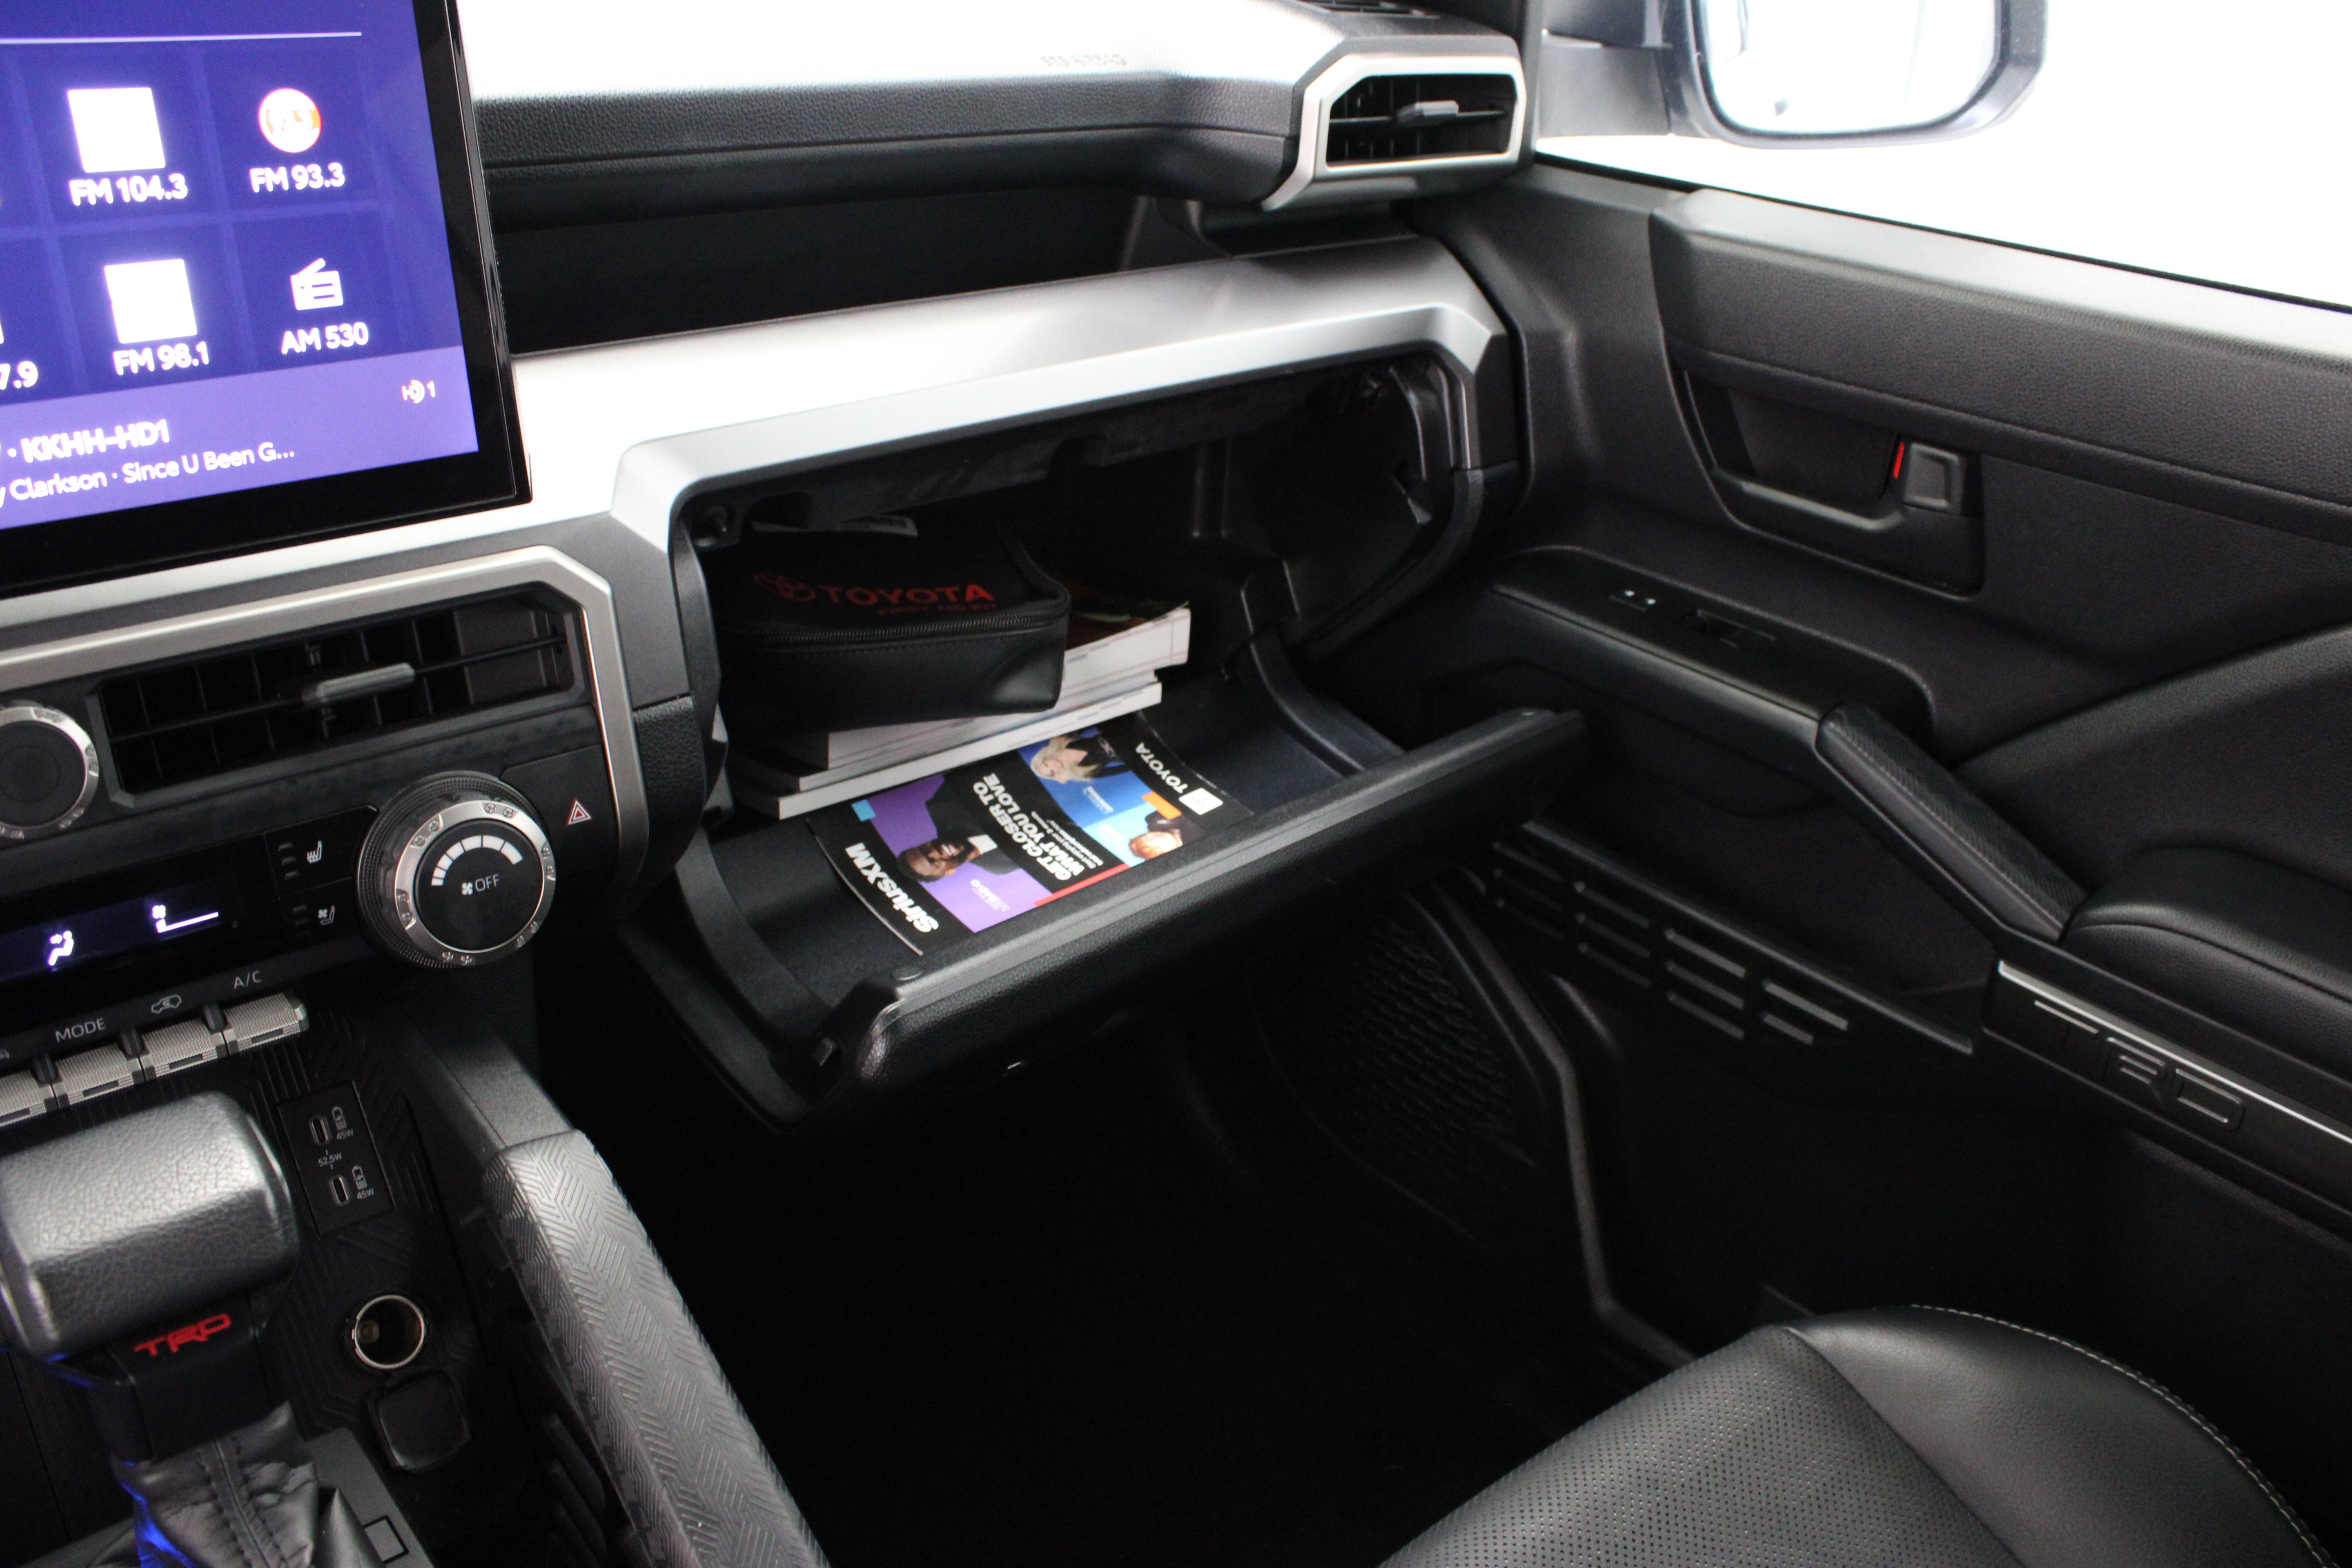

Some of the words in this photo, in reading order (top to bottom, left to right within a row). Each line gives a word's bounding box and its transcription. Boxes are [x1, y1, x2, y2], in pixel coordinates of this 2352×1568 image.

[69, 178, 114, 206] FM
[116, 173, 188, 203] 104.3
[250, 167, 289, 193] FM
[292, 163, 345, 190] 93.3
[281, 327, 322, 354] AM
[325, 322, 369, 349] 530
[113, 347, 155, 375] FM
[157, 341, 209, 371] 98.1
[426, 381, 436, 398] 1
[21, 418, 170, 463] KKHH-HD1
[9, 472, 108, 500] Clarkson
[122, 461, 180, 483] Since
[181, 453, 199, 474] U
[203, 449, 256, 471] Been
[817, 582, 996, 606] TOYOTA
[1135, 742, 1188, 794] TOYOTA
[973, 782, 995, 806] TO
[982, 773, 1020, 814] LOVE
[989, 803, 1043, 857] CLOSER
[1013, 813, 1045, 843] YOU
[1036, 855, 1071, 881] GET
[1039, 841, 1085, 876] WHAT
[475, 873, 499, 892] OFF
[845, 842, 939, 933] SiriusXM
[234, 970, 262, 989] A/C
[54, 1018, 107, 1043] MODE
[336, 1128, 354, 1140] 45W
[318, 1152, 342, 1167] 52.5W
[357, 1188, 374, 1200] 45W
[134, 1314, 232, 1356] TRD
